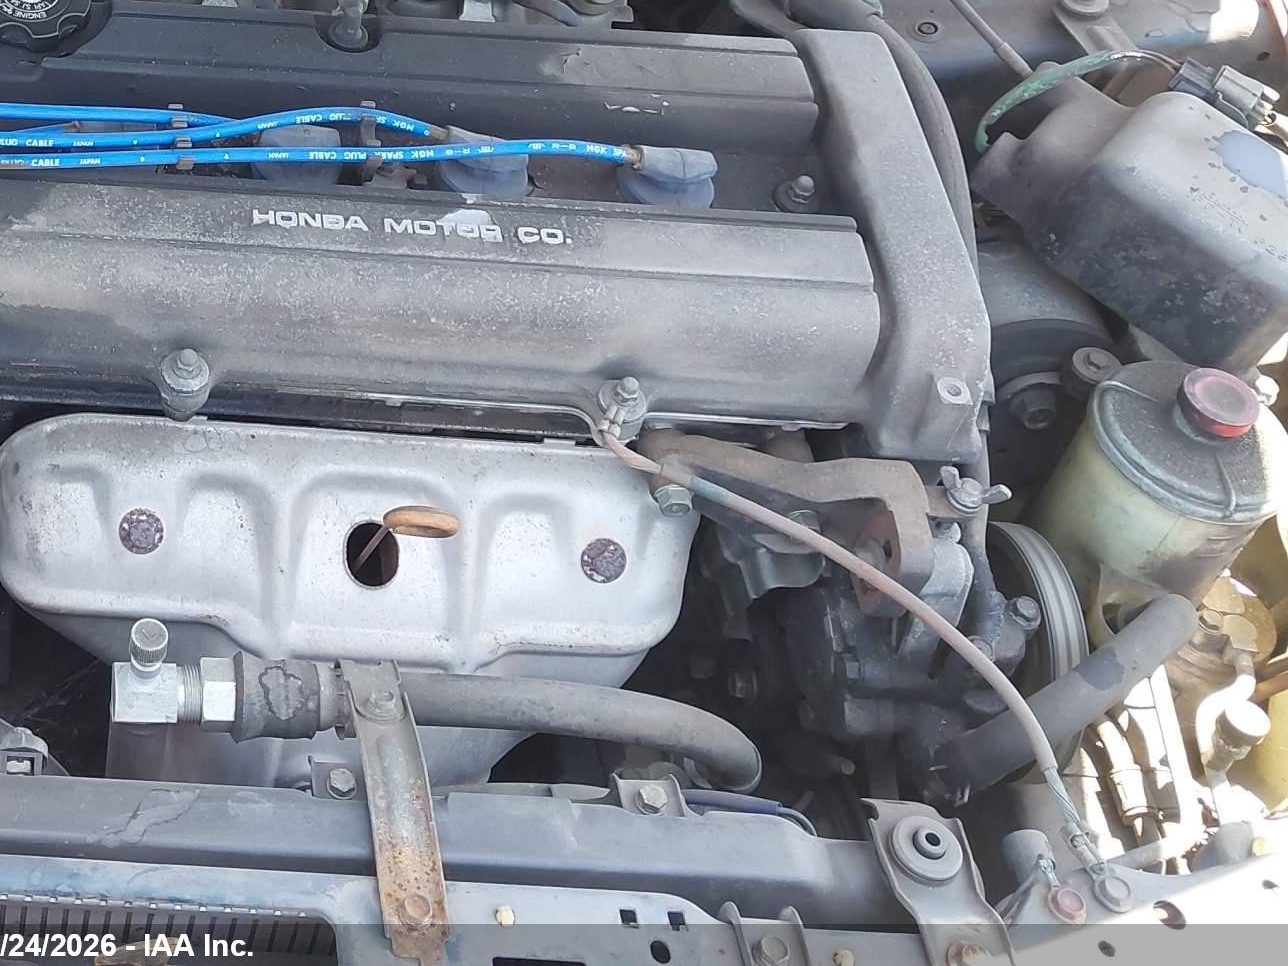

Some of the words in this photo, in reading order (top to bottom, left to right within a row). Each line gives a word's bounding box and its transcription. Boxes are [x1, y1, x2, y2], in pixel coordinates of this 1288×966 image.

[13, 9, 47, 19] ENGINE
[295, 114, 323, 124] CABLE
[329, 112, 352, 122] LUG
[257, 120, 279, 130] JAPAN
[392, 119, 415, 132] NGK
[25, 138, 54, 147] CABLE
[410, 150, 434, 159] NGK
[586, 144, 607, 155] NGK
[308, 151, 337, 160] CABLE
[343, 151, 367, 160] PLUG
[31, 158, 60, 167] CABLE
[252, 210, 369, 232] HONDA
[384, 219, 504, 244] MOTOR
[517, 225, 573, 245] CO.
